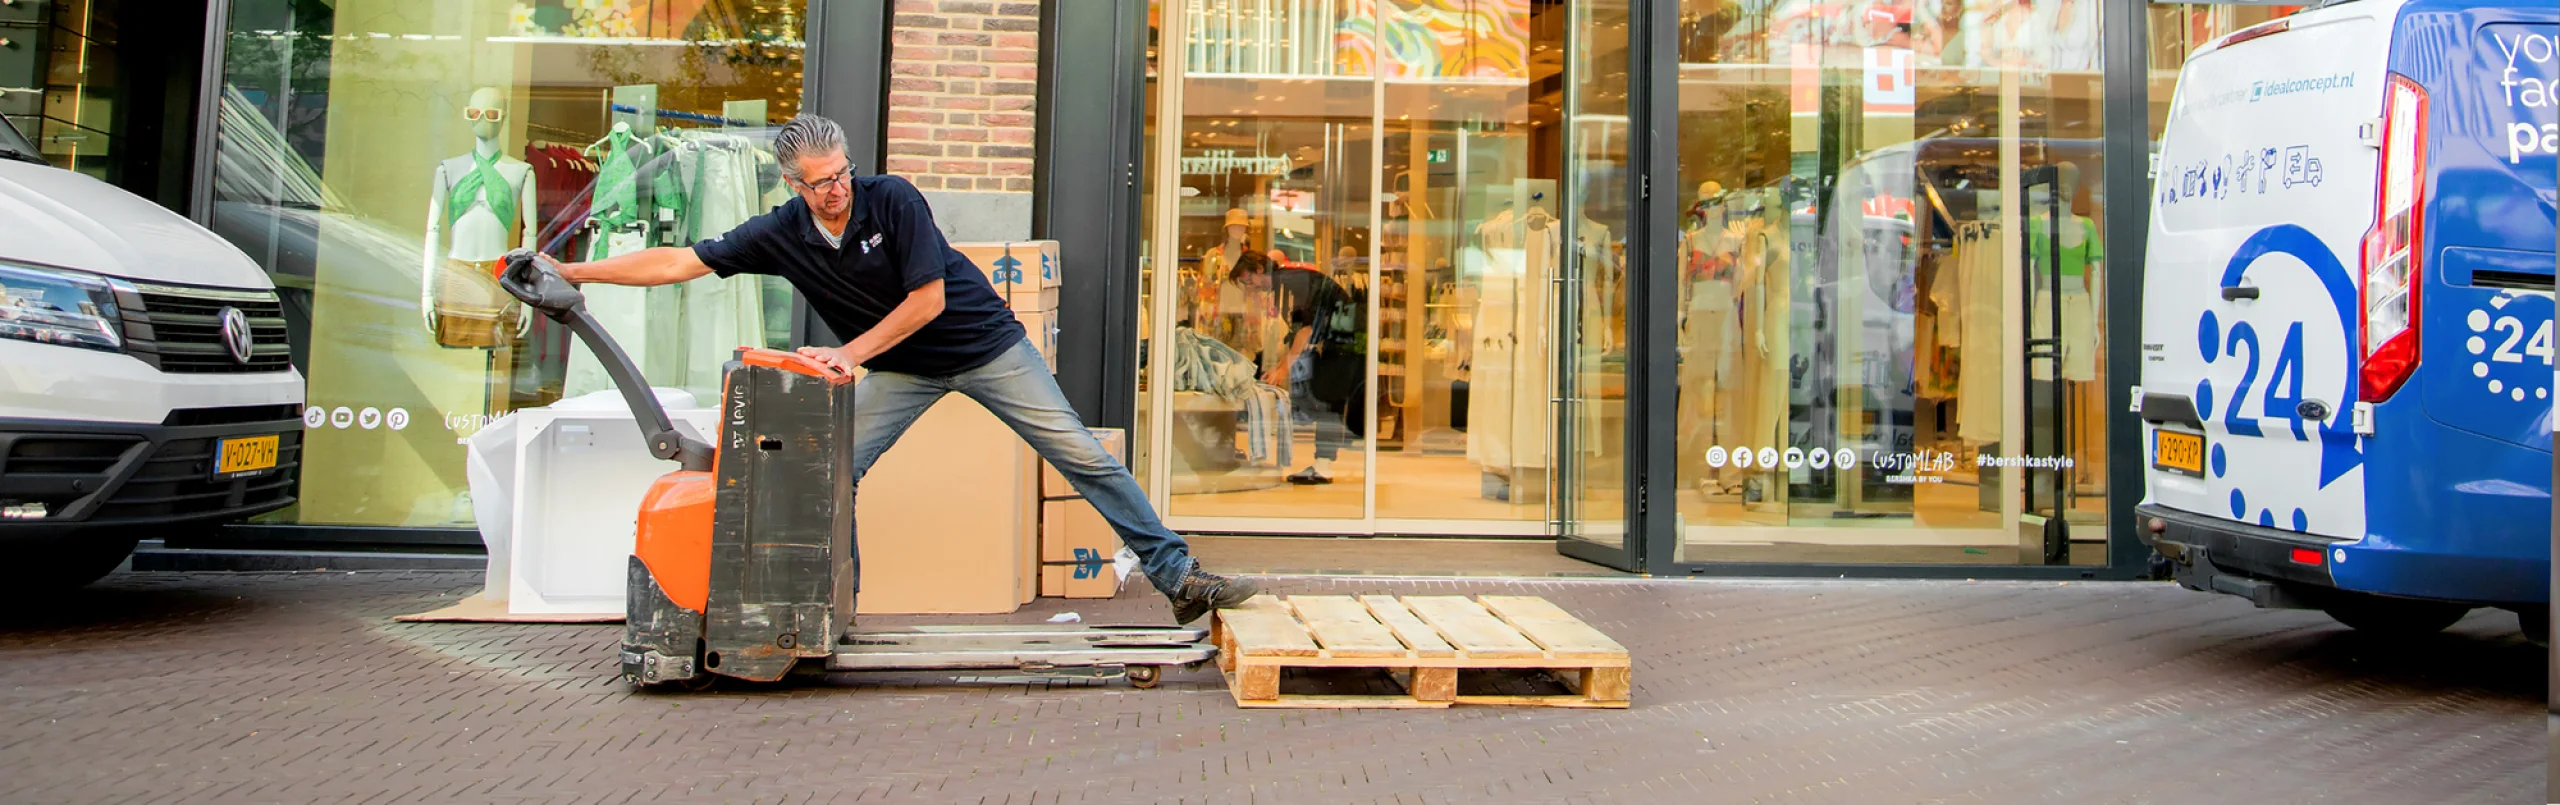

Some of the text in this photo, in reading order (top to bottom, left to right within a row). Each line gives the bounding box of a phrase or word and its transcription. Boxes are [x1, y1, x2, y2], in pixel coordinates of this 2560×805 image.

[2263, 71, 2355, 97] idealconcept.nl
[2492, 315, 2555, 365] 24
[2225, 320, 2309, 441] 24
[225, 440, 275, 467] V-027-VH
[1976, 453, 2074, 471] #bershkastyle
[2158, 437, 2199, 465] V-290-XP
[1929, 475, 1944, 484] YOU
[1079, 553, 1087, 574] TP
